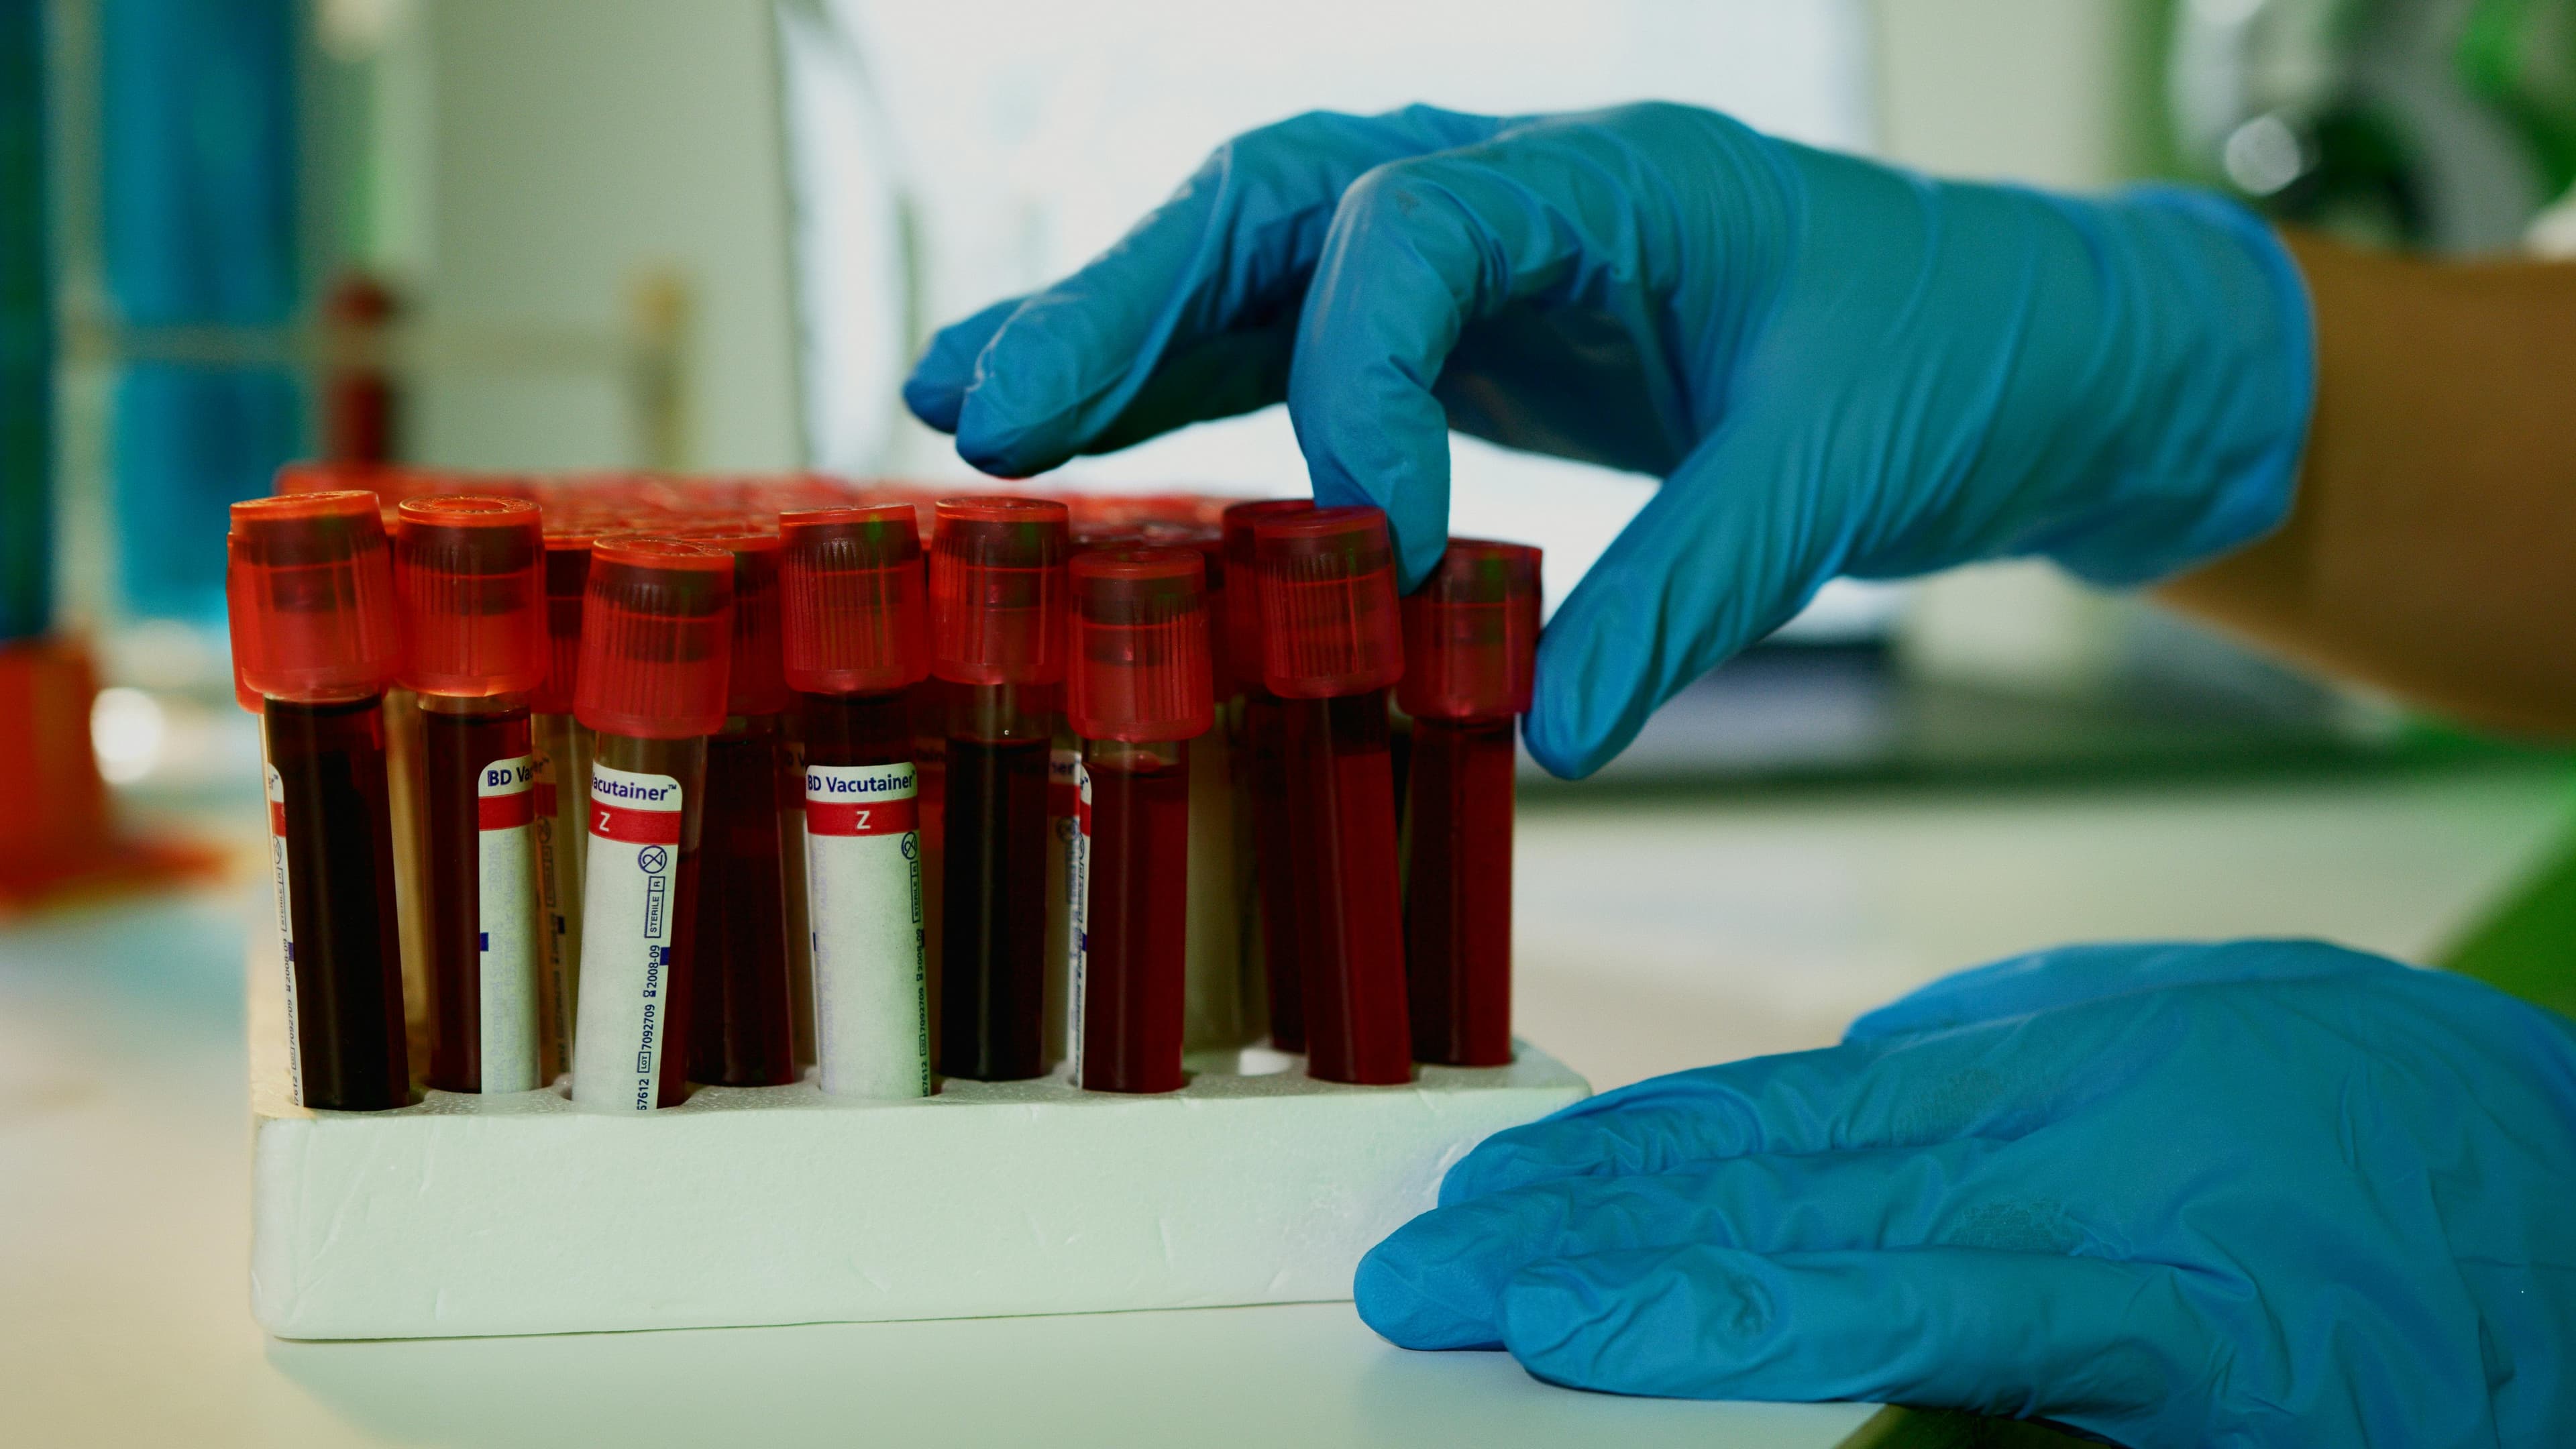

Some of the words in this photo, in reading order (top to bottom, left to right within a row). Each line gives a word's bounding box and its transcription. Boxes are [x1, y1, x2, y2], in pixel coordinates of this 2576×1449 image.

[487, 769, 512, 787] BD
[808, 774, 822, 791] BD
[599, 811, 611, 833] Z
[856, 810, 871, 830] Z
[650, 896, 660, 932] STERILE
[647, 945, 660, 988] 2008-09
[641, 1004, 655, 1050] 7092709
